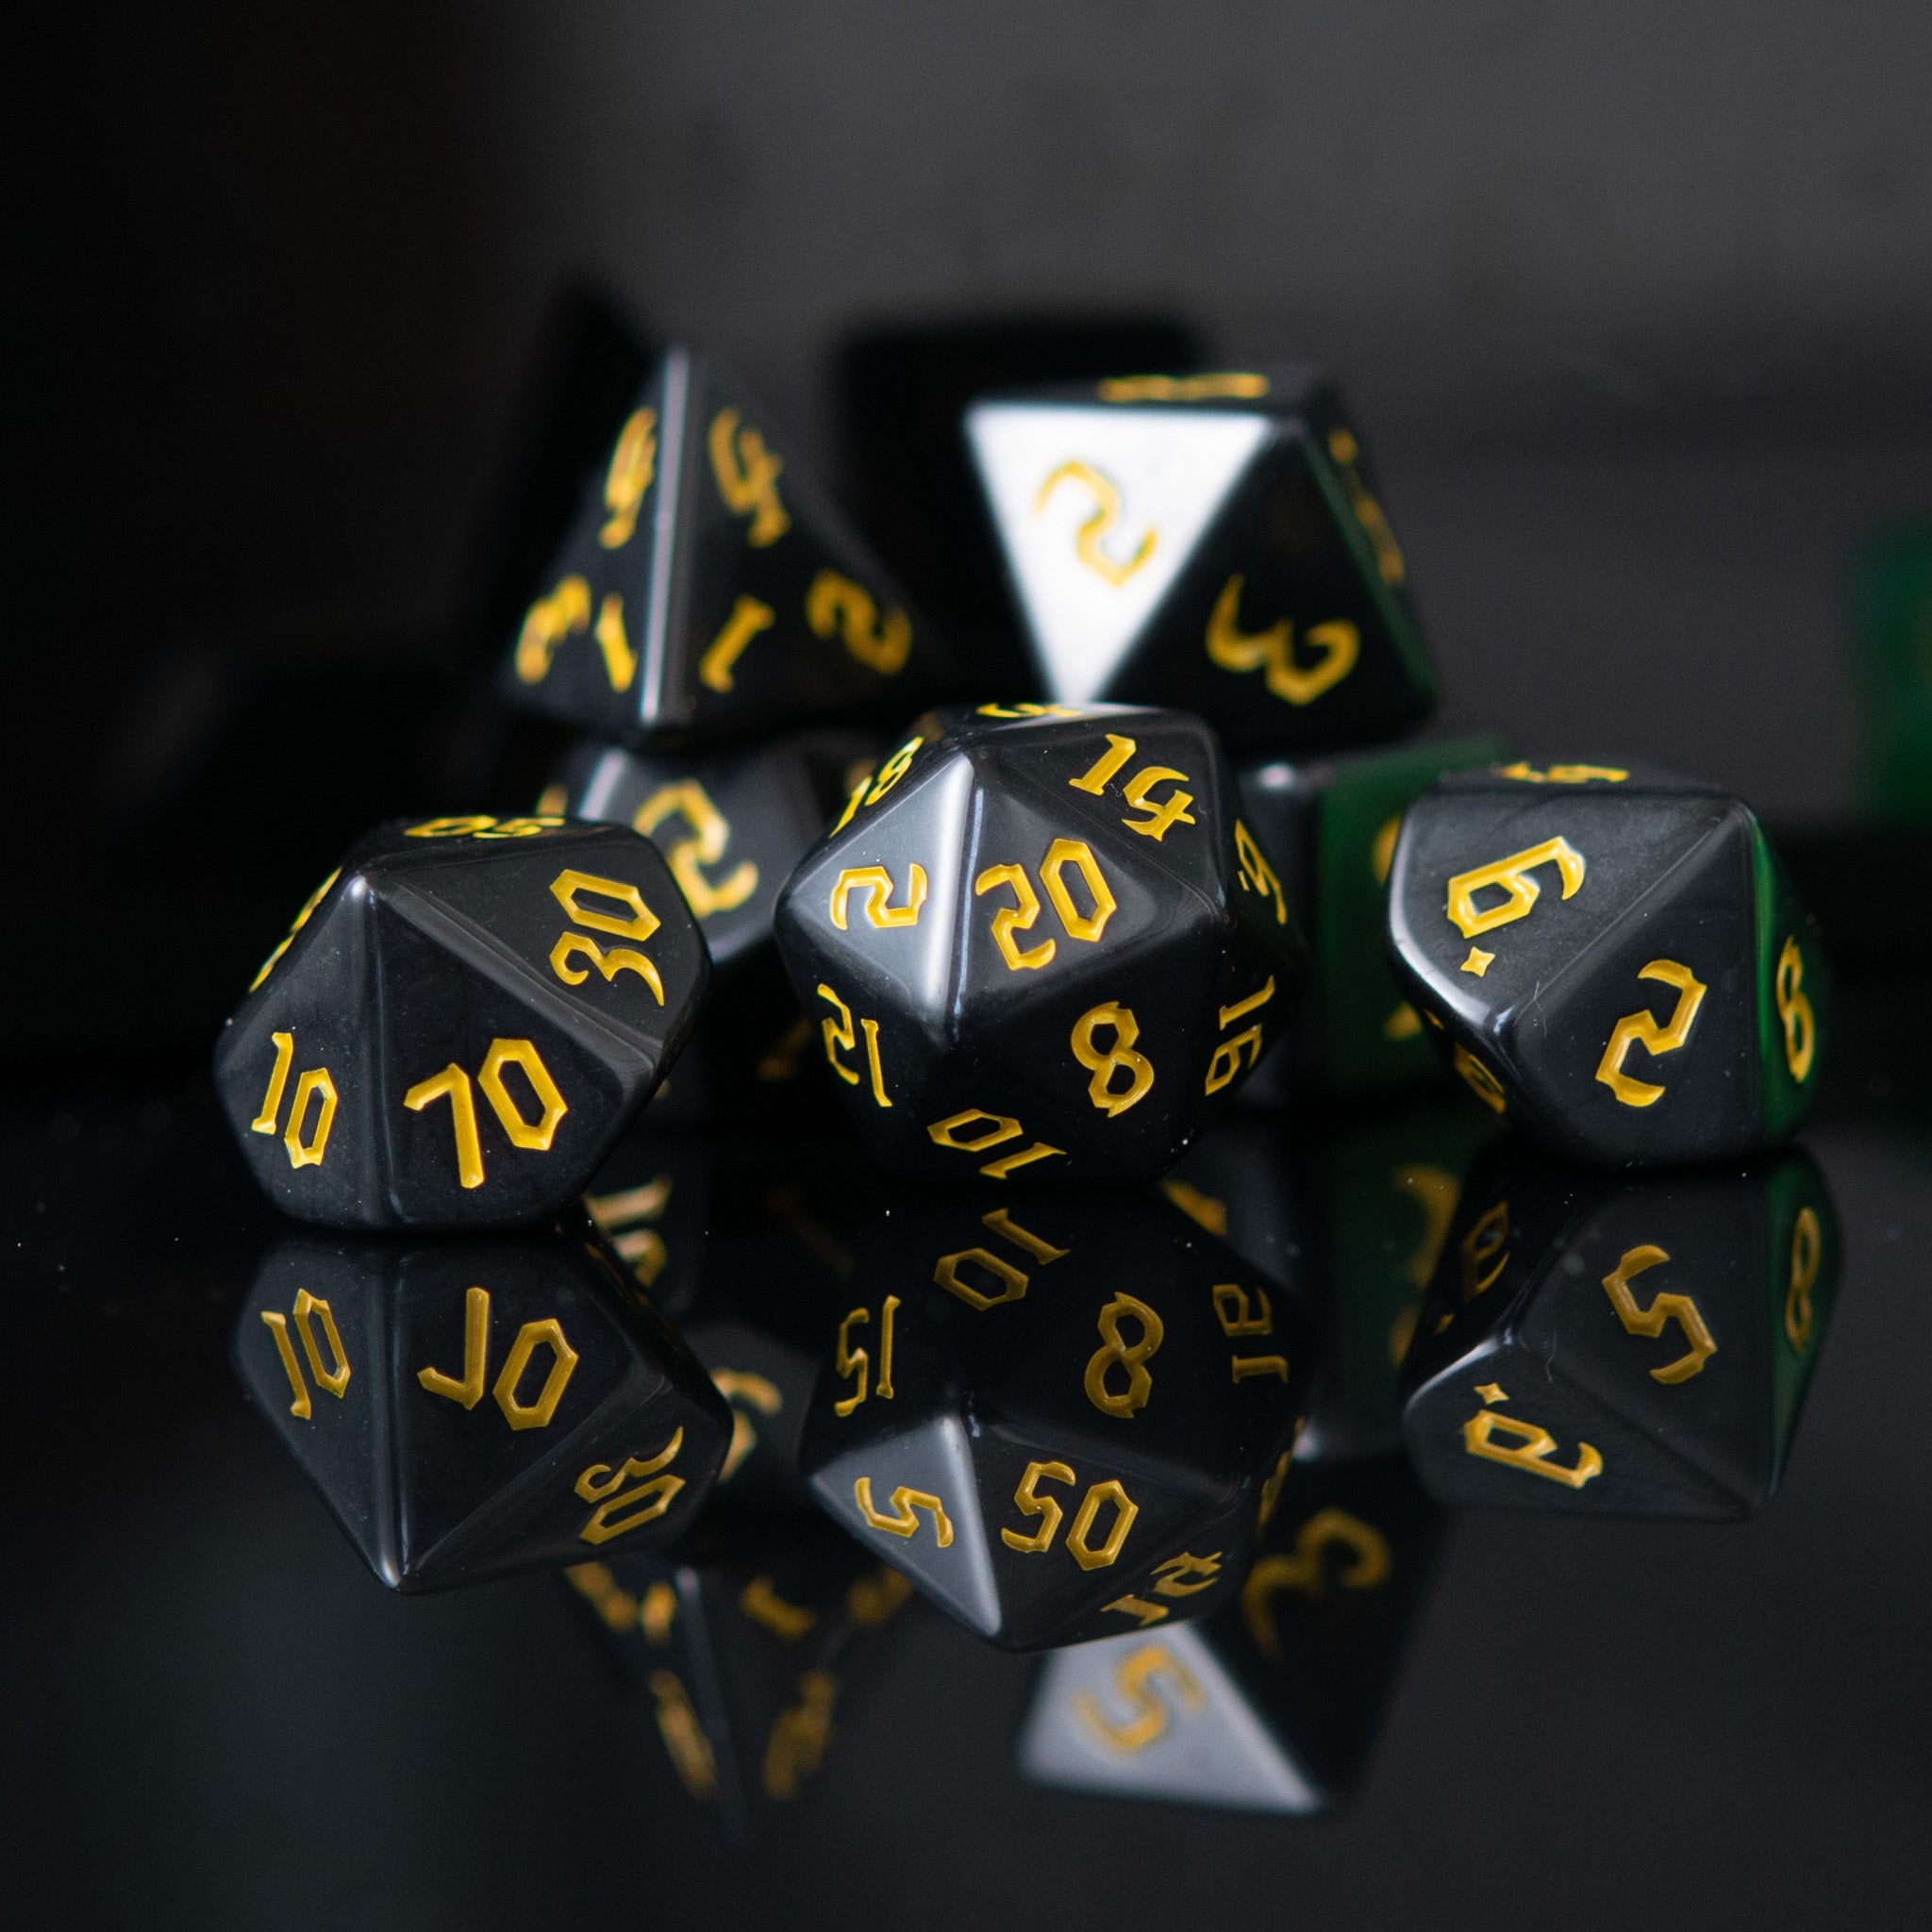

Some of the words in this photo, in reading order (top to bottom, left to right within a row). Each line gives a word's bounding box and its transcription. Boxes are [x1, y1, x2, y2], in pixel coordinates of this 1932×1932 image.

[708, 408, 791, 548] 4
[699, 593, 776, 693] 1
[1204, 572, 1361, 707] 3
[1068, 732, 1196, 842] 14
[549, 868, 666, 1008] 30
[974, 836, 1119, 972] 20
[1069, 999, 1157, 1119] 8
[1774, 935, 1816, 1085] 8
[250, 1030, 340, 1170] 10
[402, 1037, 570, 1191] 70
